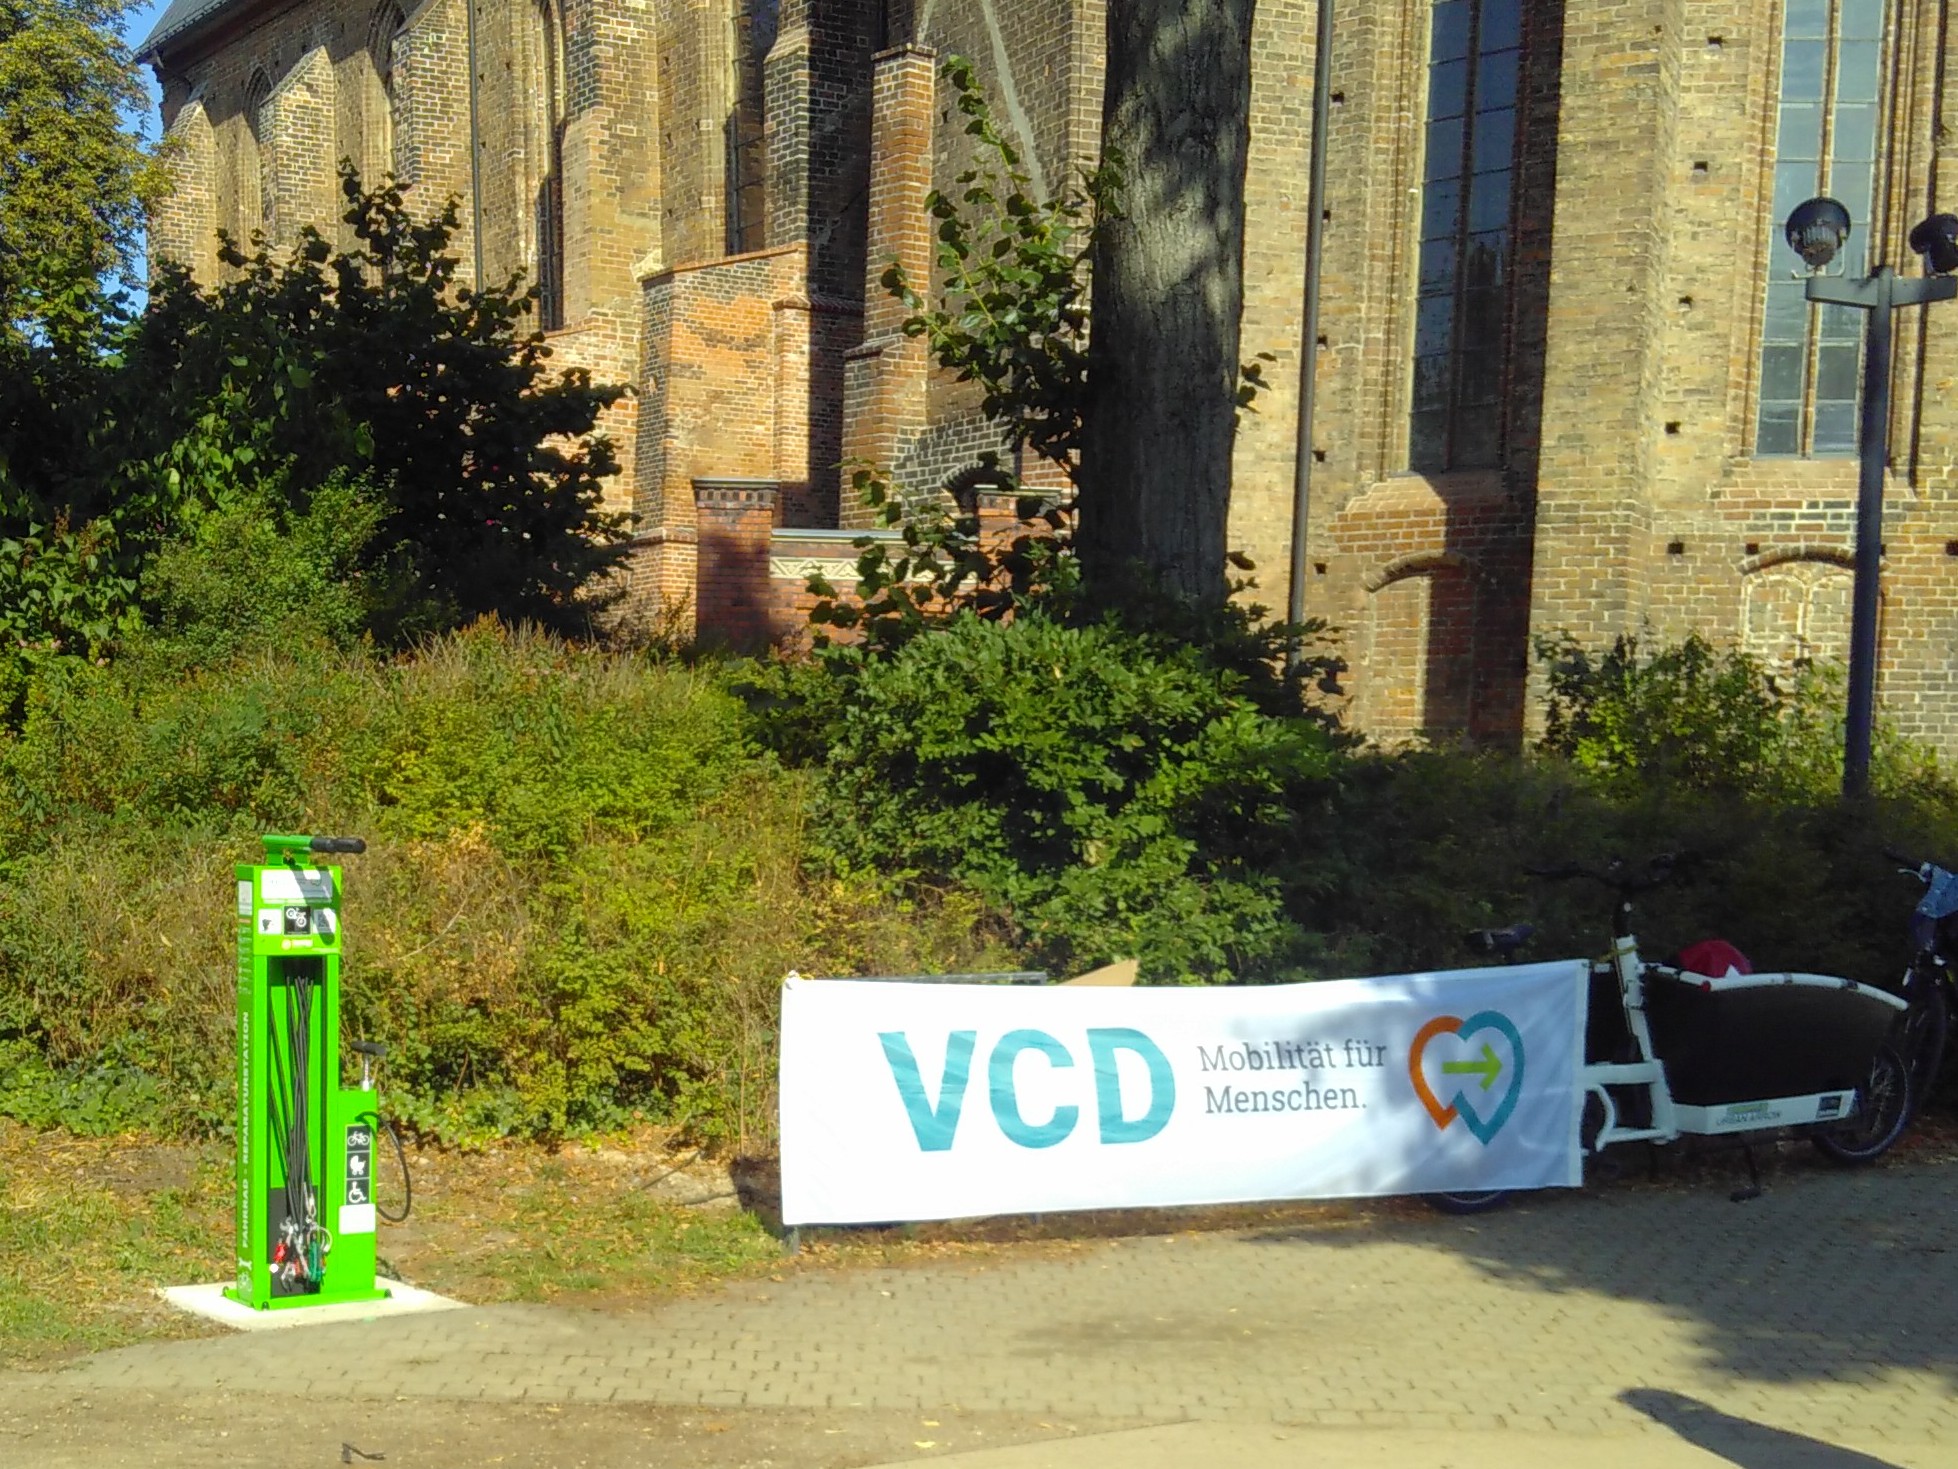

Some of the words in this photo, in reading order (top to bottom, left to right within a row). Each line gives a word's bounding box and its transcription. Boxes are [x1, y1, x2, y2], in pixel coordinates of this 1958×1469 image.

[1197, 1042, 1336, 1071] Mobilität
[1344, 1038, 1387, 1067] für
[877, 1028, 1176, 1151] VCD
[1204, 1081, 1367, 1114] Menschen.
